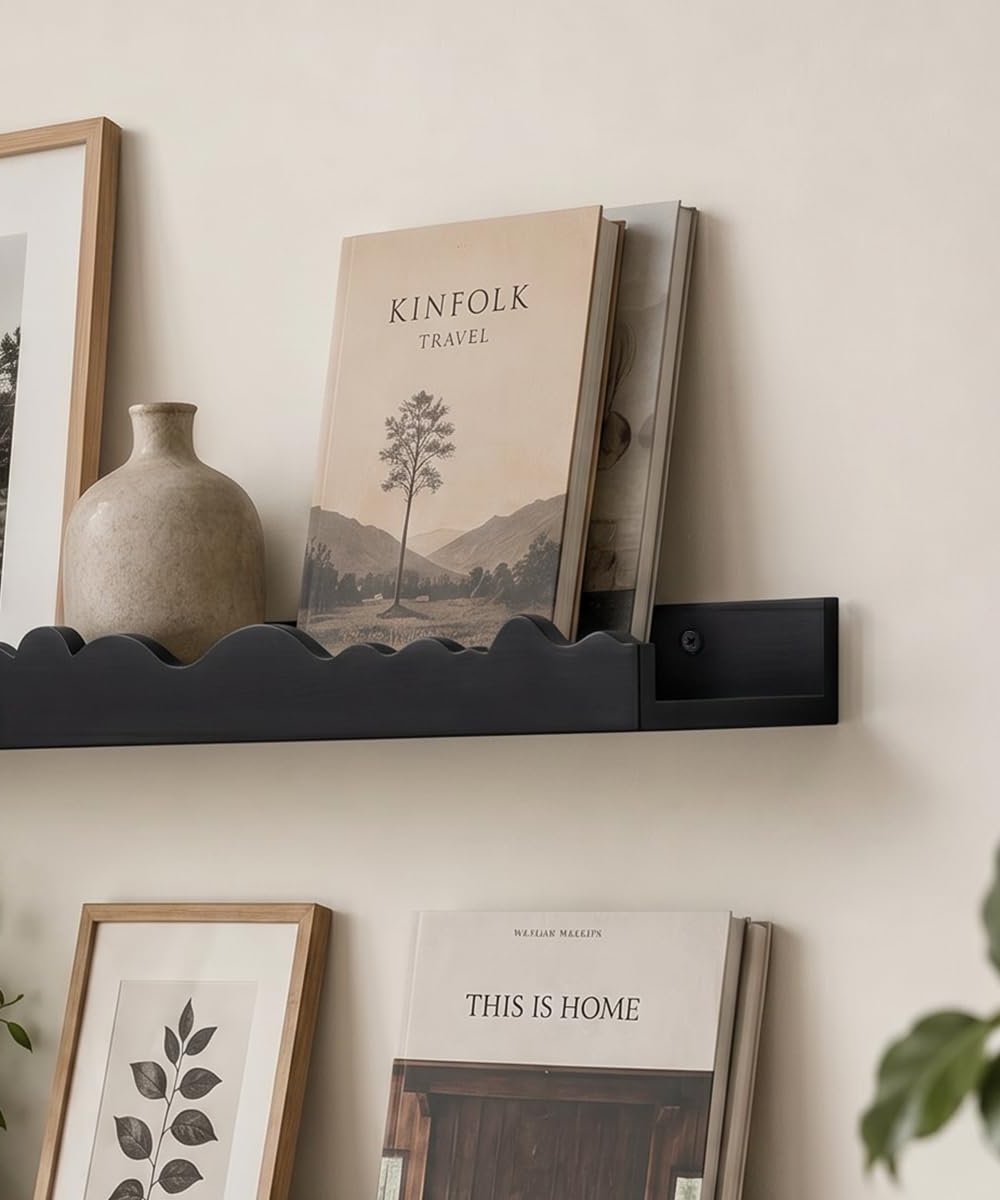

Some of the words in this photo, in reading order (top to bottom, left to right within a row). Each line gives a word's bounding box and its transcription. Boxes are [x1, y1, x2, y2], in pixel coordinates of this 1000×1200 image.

[388, 284, 529, 323] KINFOLK
[418, 328, 489, 349] TRAVEL
[465, 993, 524, 1018] THIS
[531, 994, 553, 1019] IS
[560, 996, 641, 1021] HOME
